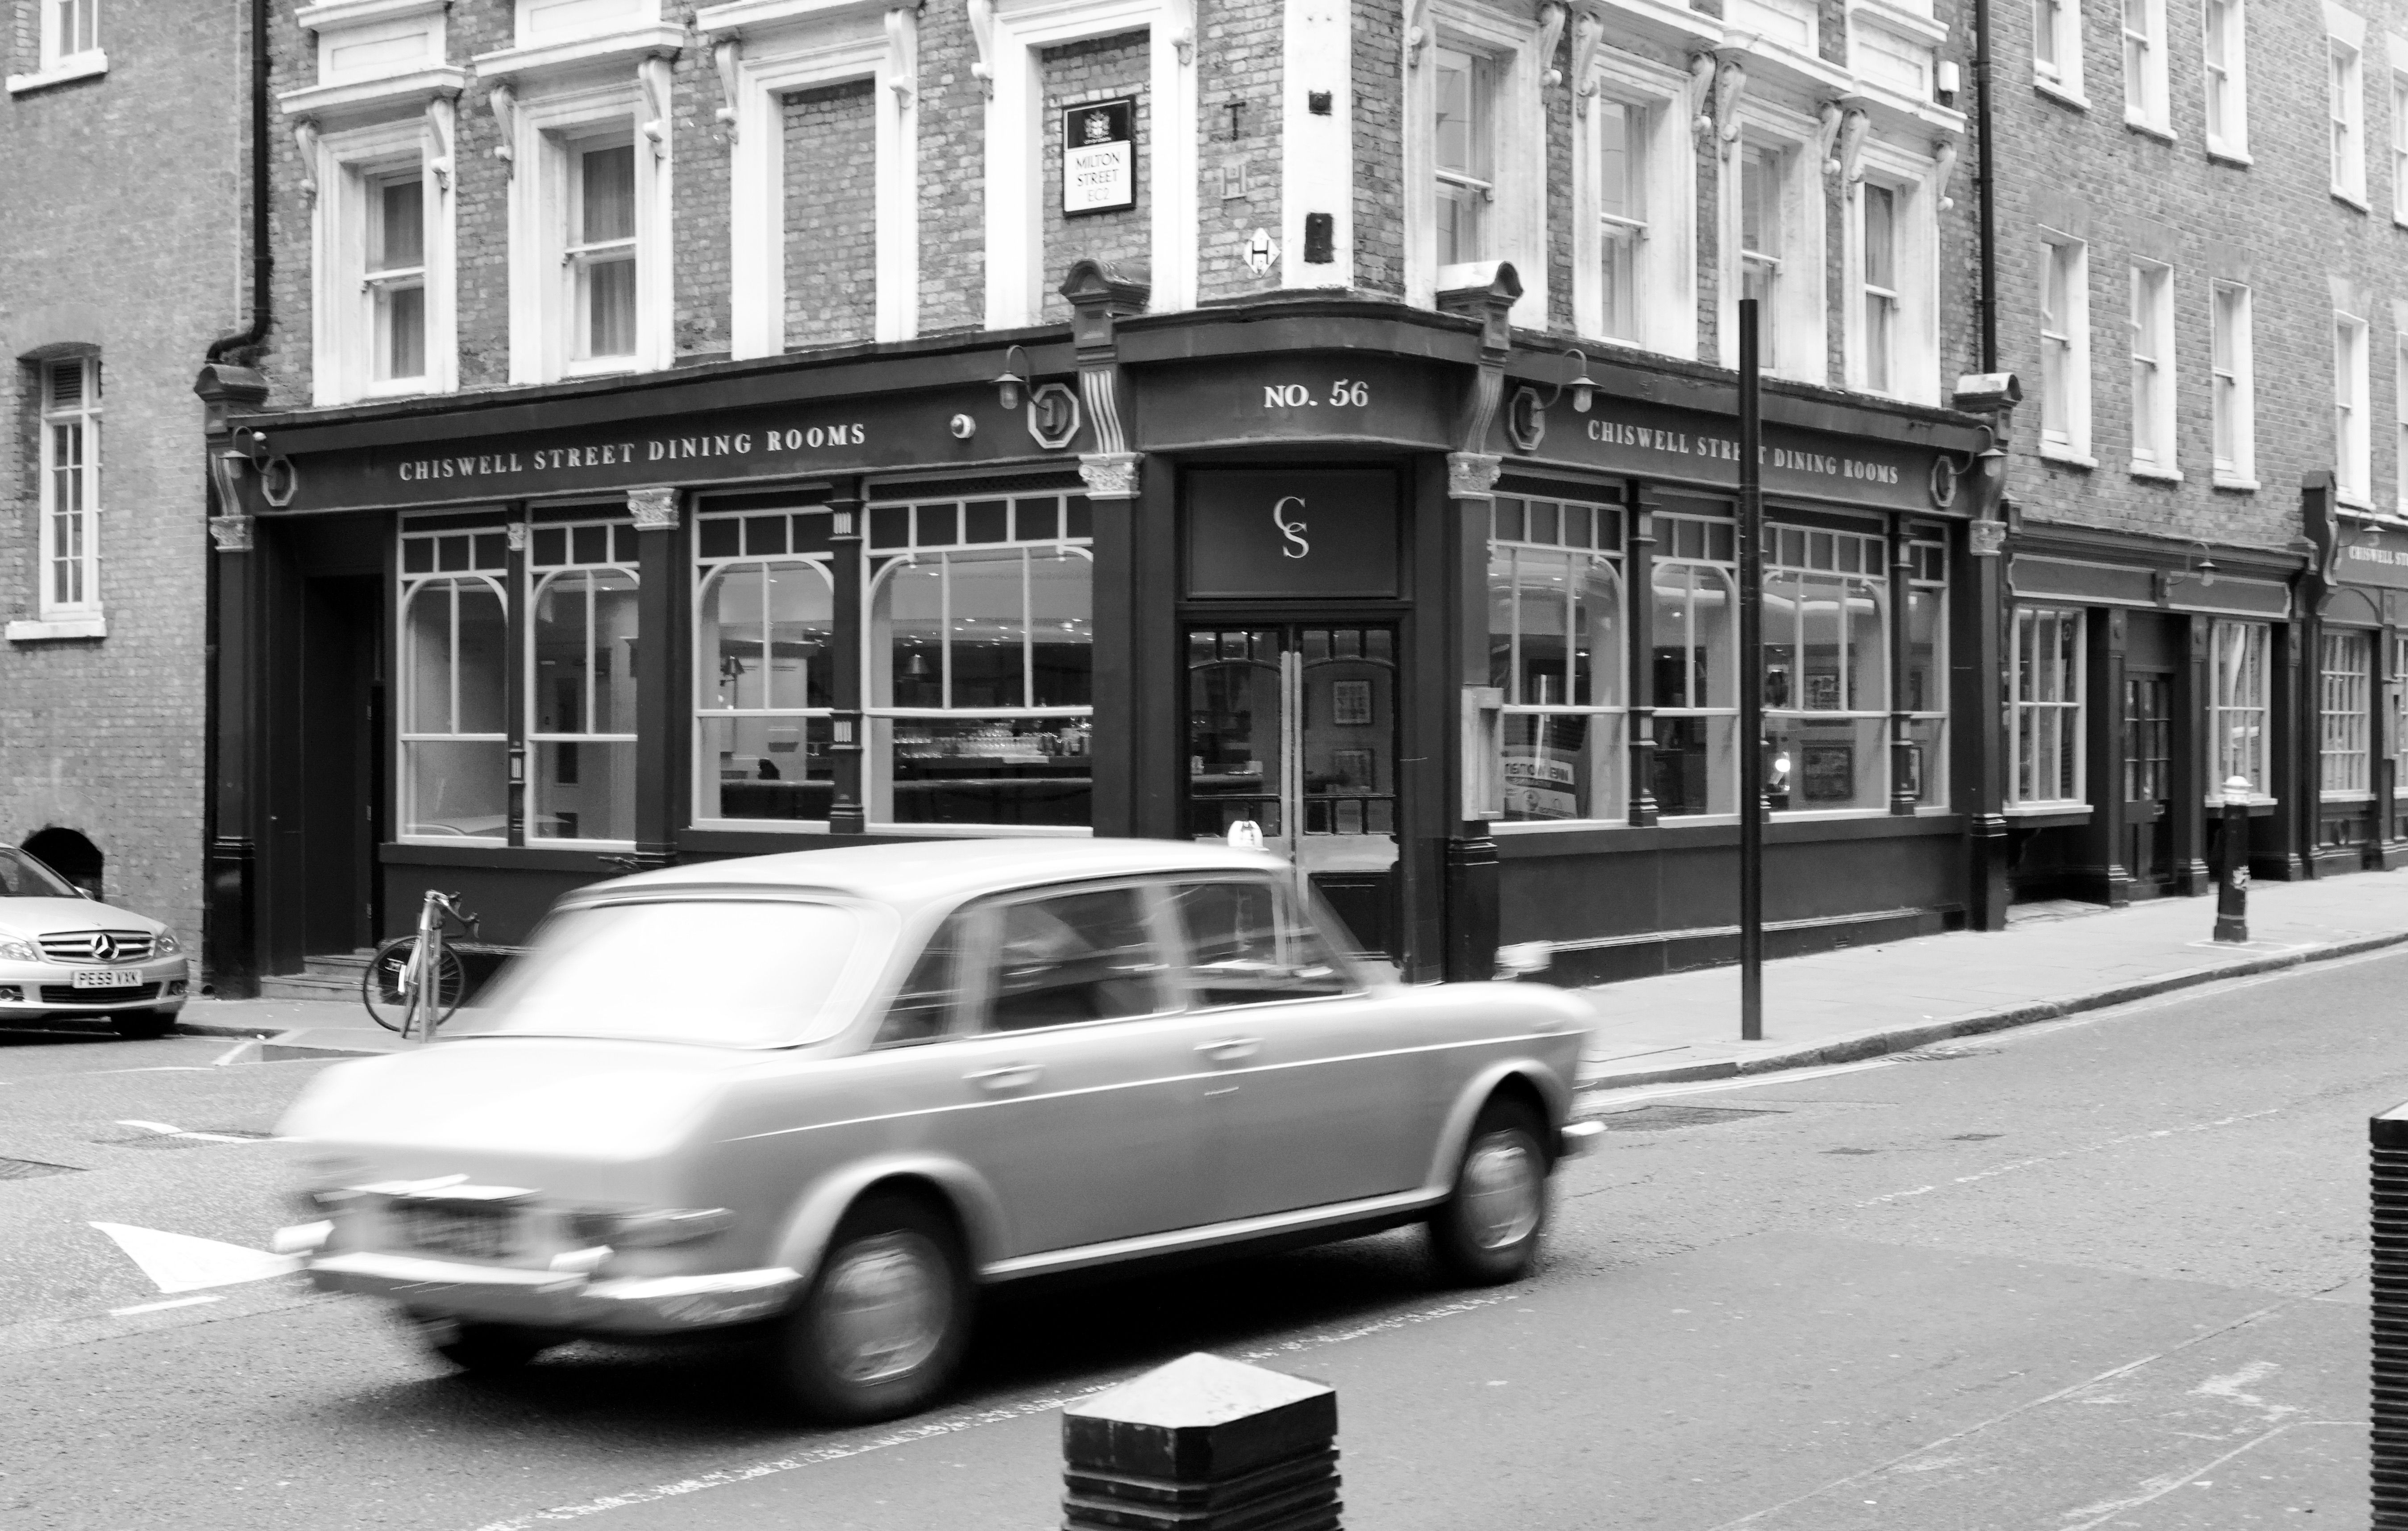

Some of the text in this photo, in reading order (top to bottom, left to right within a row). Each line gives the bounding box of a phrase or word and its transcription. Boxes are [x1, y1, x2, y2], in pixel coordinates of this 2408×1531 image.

[1075, 152, 1121, 170] MILTON
[1077, 169, 1119, 187] STREET
[1087, 187, 1110, 202] EC2
[1252, 240, 1269, 266] H
[1263, 378, 1369, 408] NO. 56
[399, 423, 866, 480] CHISWELL STREET DINING ROOMS
[1587, 419, 1898, 484] CHISWELL STRET DINING ROOMS
